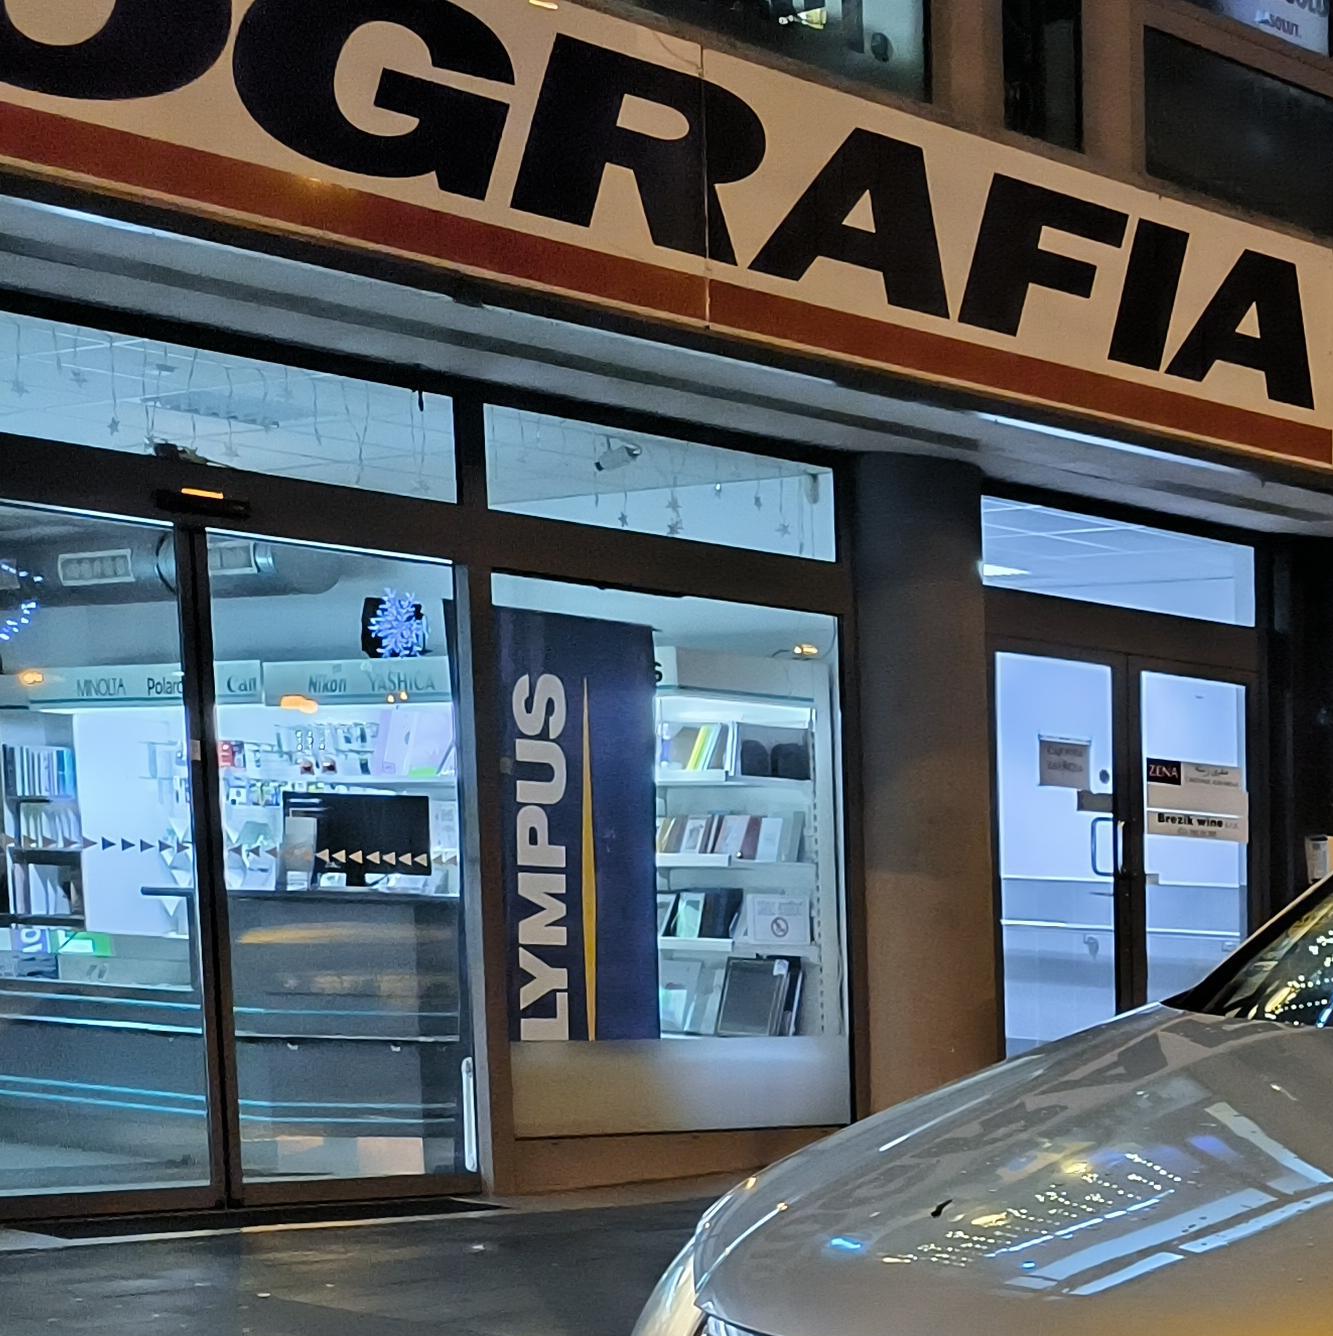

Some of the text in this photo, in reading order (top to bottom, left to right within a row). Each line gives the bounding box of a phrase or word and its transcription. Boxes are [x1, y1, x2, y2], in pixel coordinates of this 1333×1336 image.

[76, 677, 127, 697] MINOLTA
[308, 671, 436, 693] Nikon YASHICA
[1148, 764, 1179, 779] ZENA
[1196, 818, 1224, 828] wine
